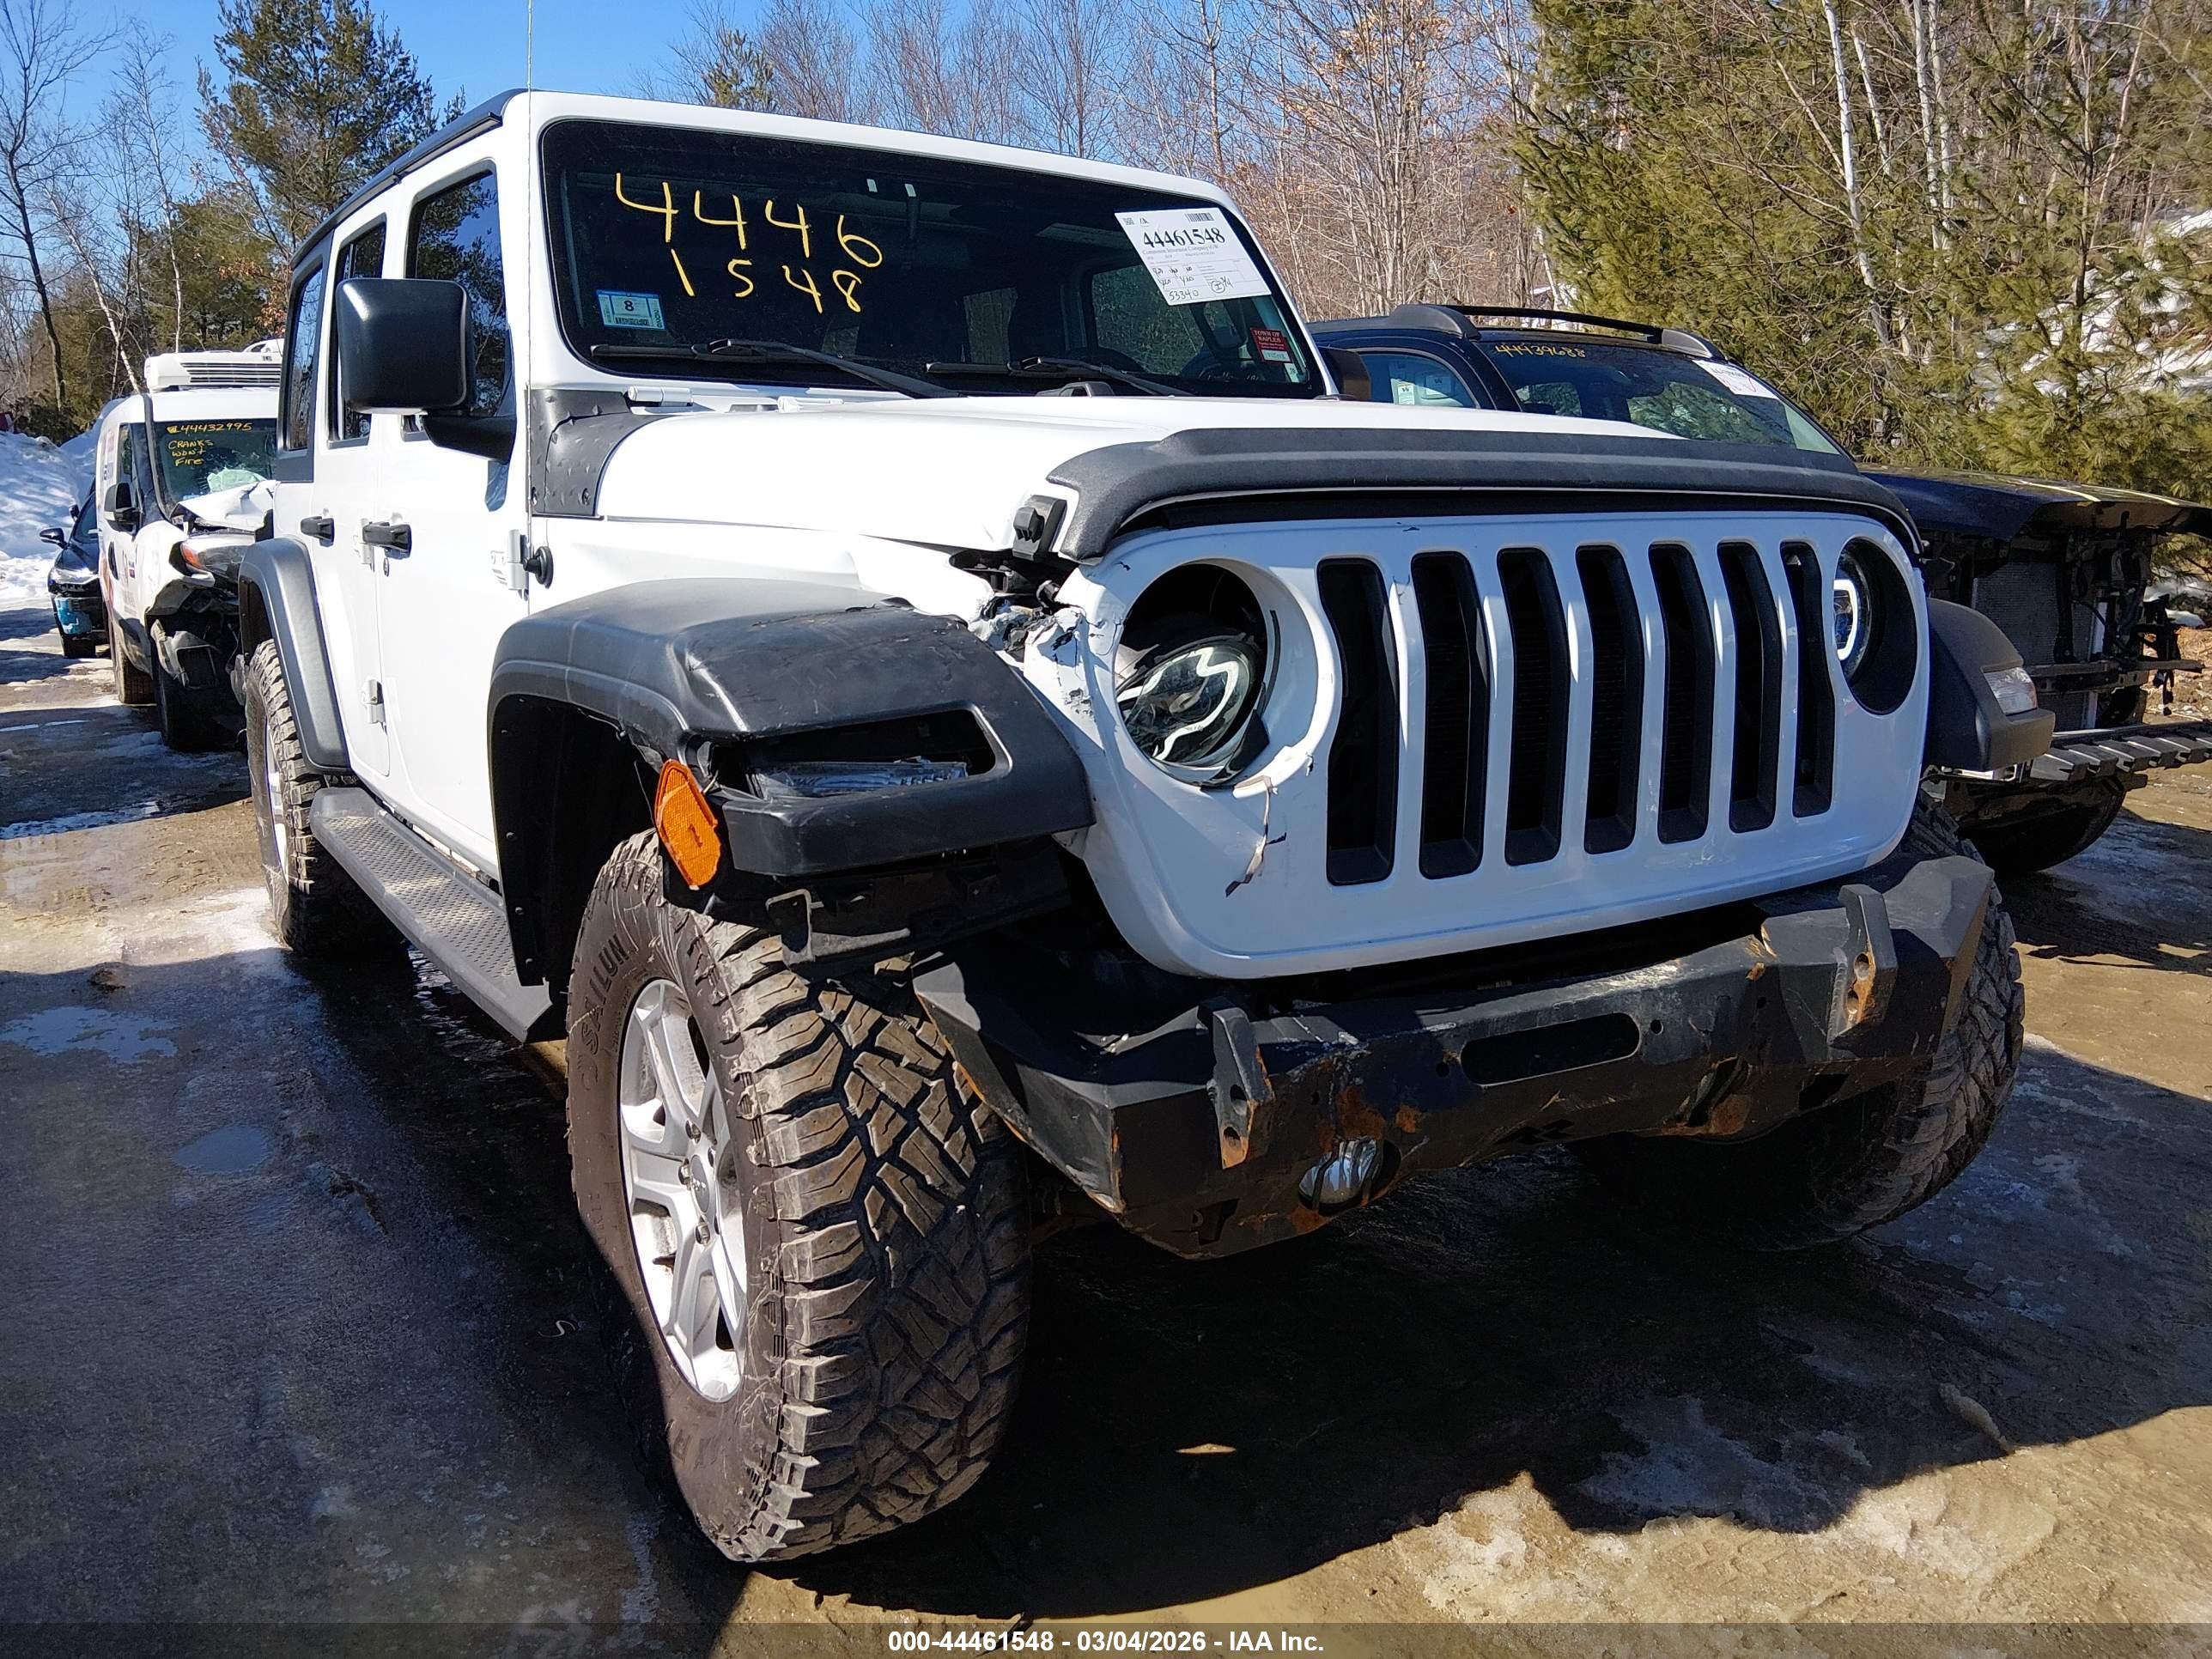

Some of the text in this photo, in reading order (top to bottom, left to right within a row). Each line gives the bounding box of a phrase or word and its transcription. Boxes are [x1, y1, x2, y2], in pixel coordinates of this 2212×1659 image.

[616, 172, 883, 267] 4446
[1143, 227, 1225, 248] 44461548
[671, 247, 862, 313] 1548
[1169, 289, 1200, 301] 53340
[624, 300, 635, 312] 8
[1495, 343, 1586, 358] 44439688
